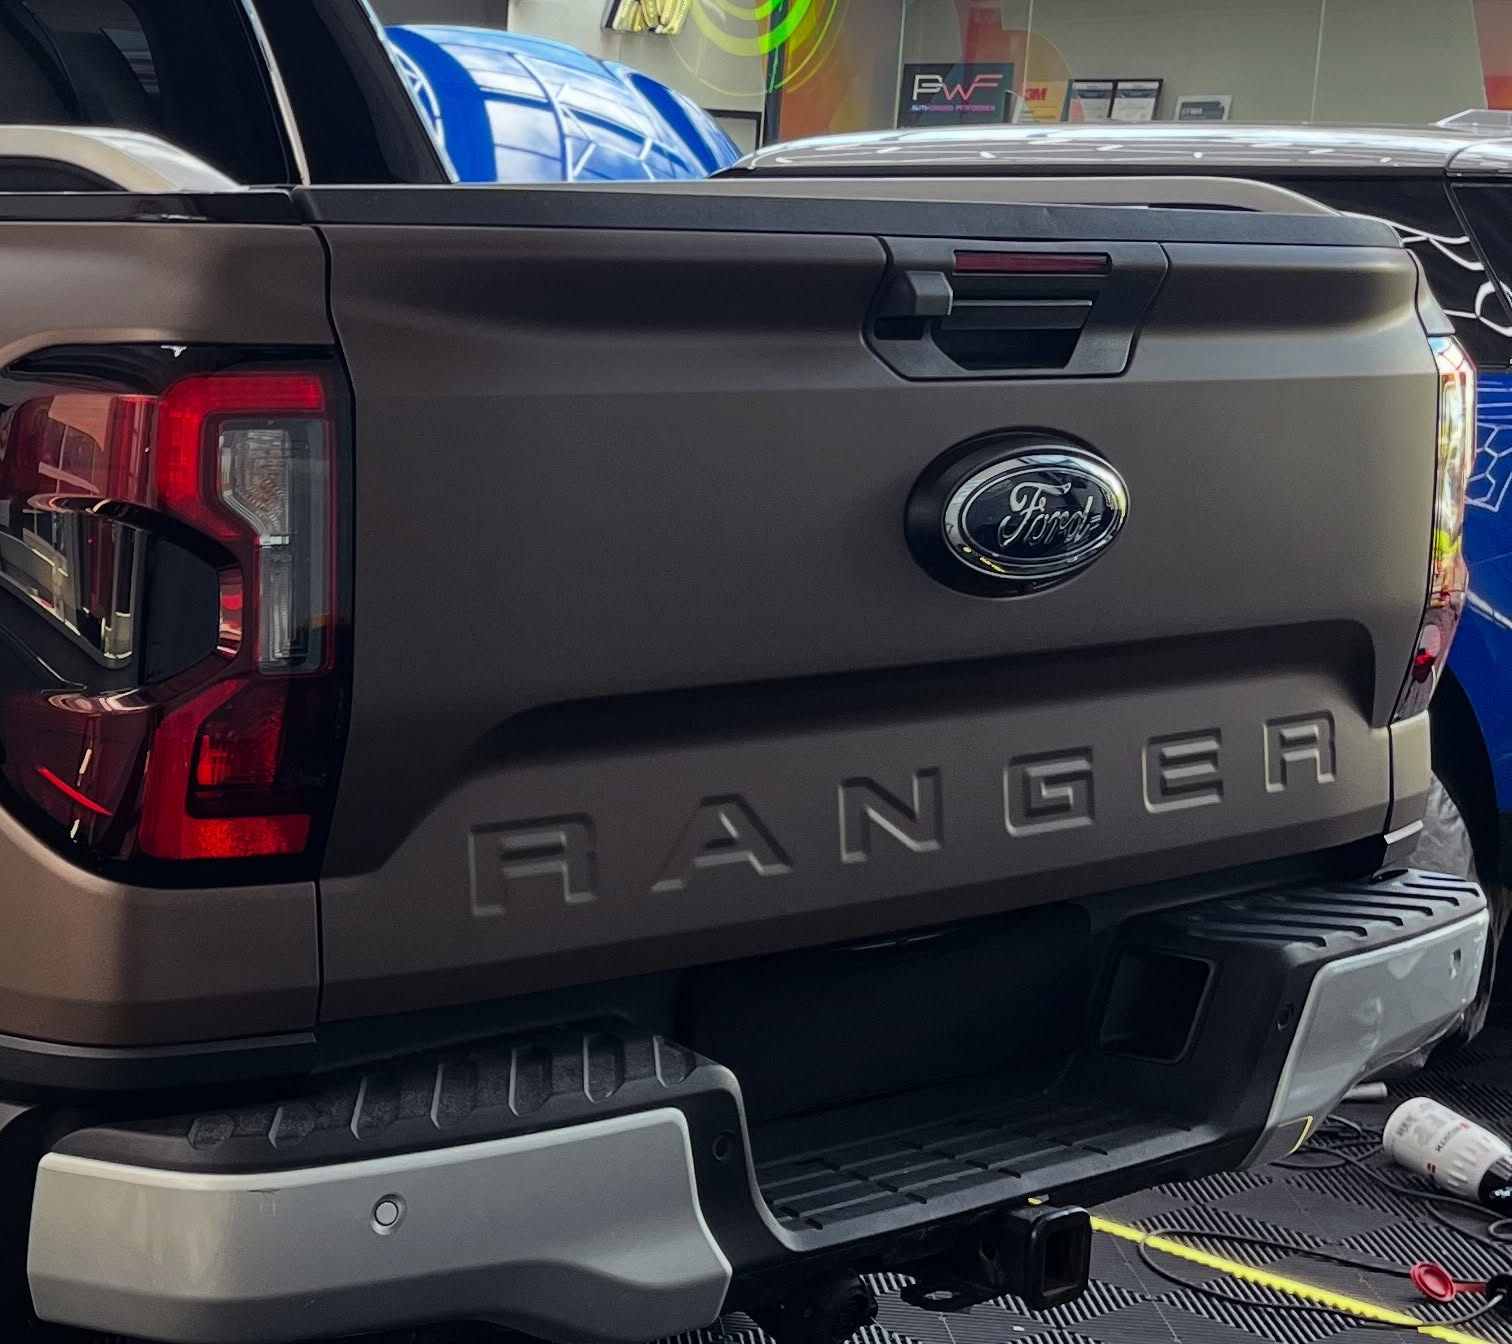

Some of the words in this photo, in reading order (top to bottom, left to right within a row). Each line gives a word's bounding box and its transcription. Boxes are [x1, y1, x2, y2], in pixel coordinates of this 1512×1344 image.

[912, 74, 1003, 101] PWF
[1025, 87, 1048, 101] 3M
[998, 481, 1093, 547] Ford
[468, 708, 1339, 919] RANGER
